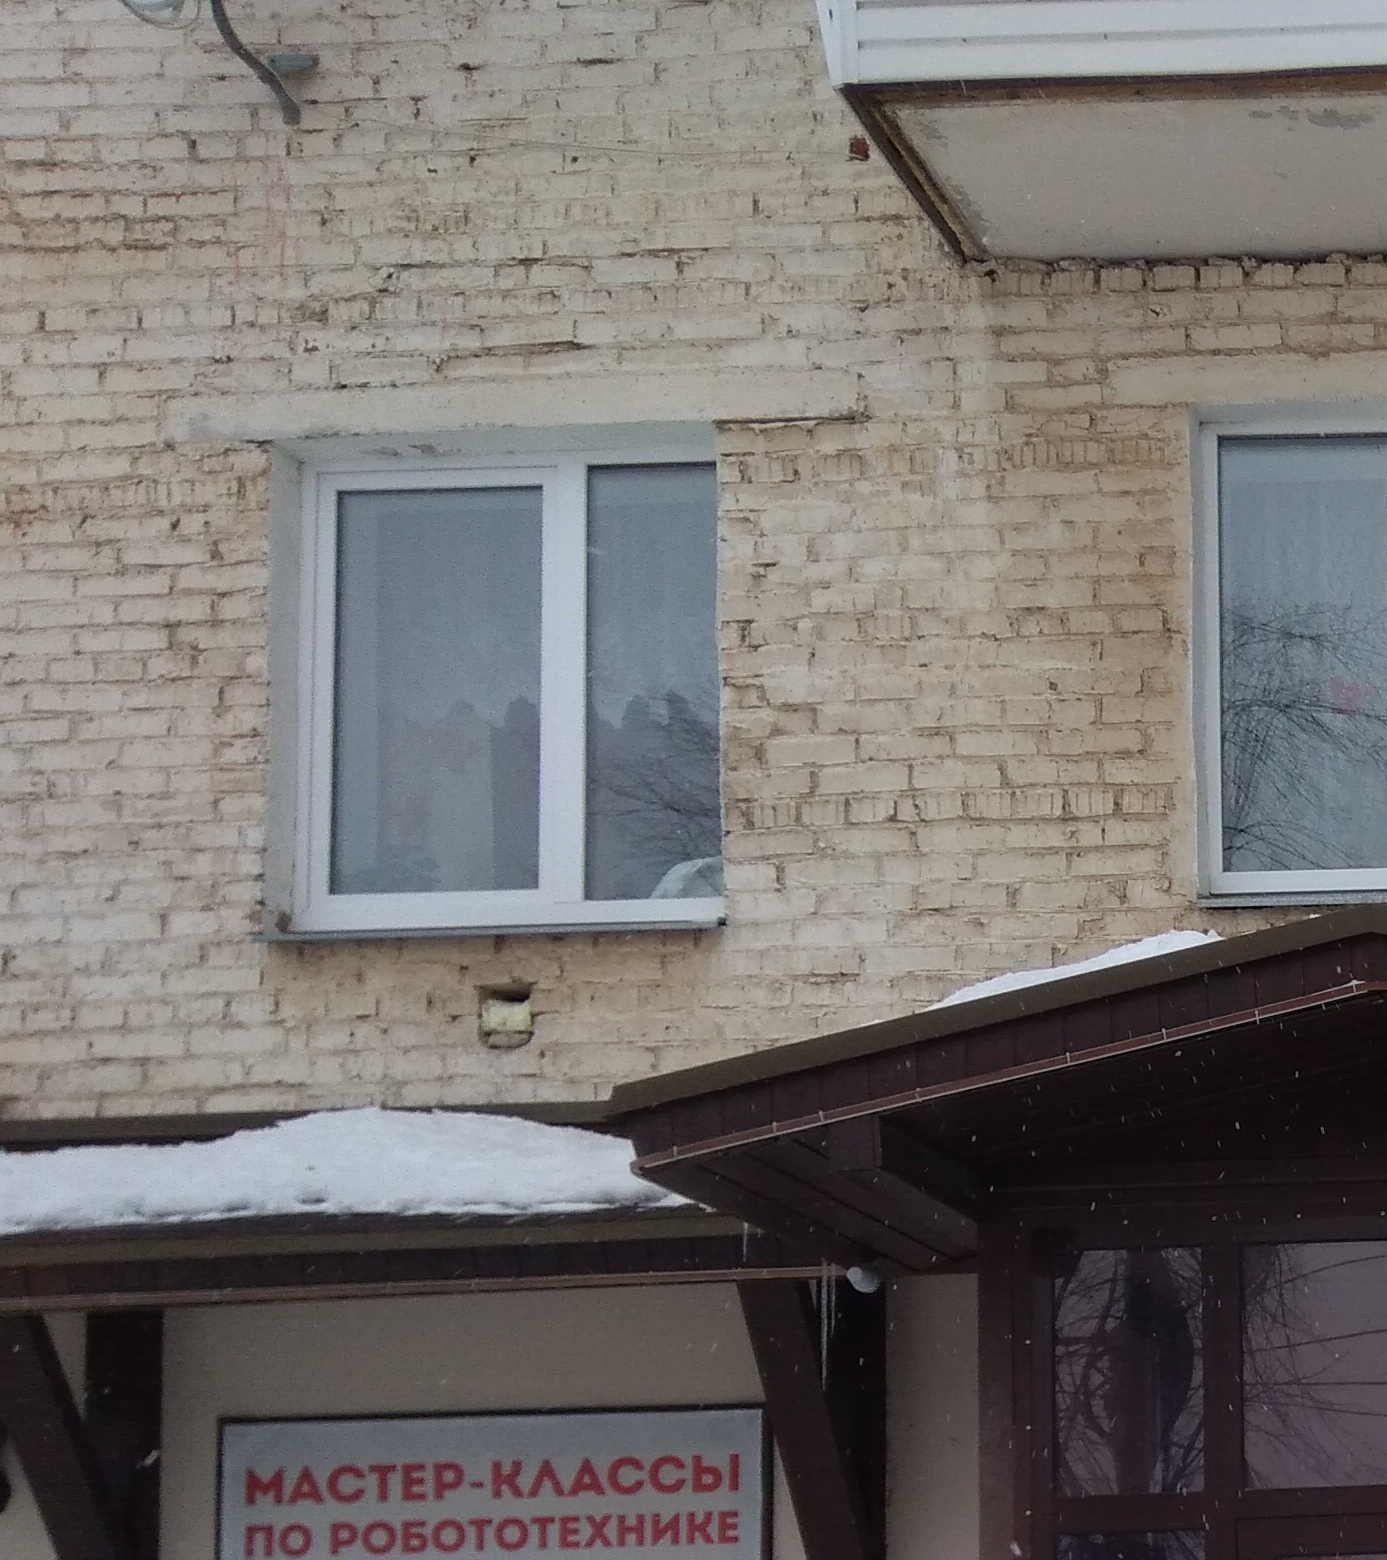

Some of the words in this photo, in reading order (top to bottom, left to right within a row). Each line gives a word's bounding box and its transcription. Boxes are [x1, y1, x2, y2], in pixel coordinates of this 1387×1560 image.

[244, 1452, 741, 1507] МАСТЕР-КЛАССЫ
[244, 1522, 314, 1560] ПО
[329, 1509, 741, 1556] РОБОТОТЕХНИКЕ
